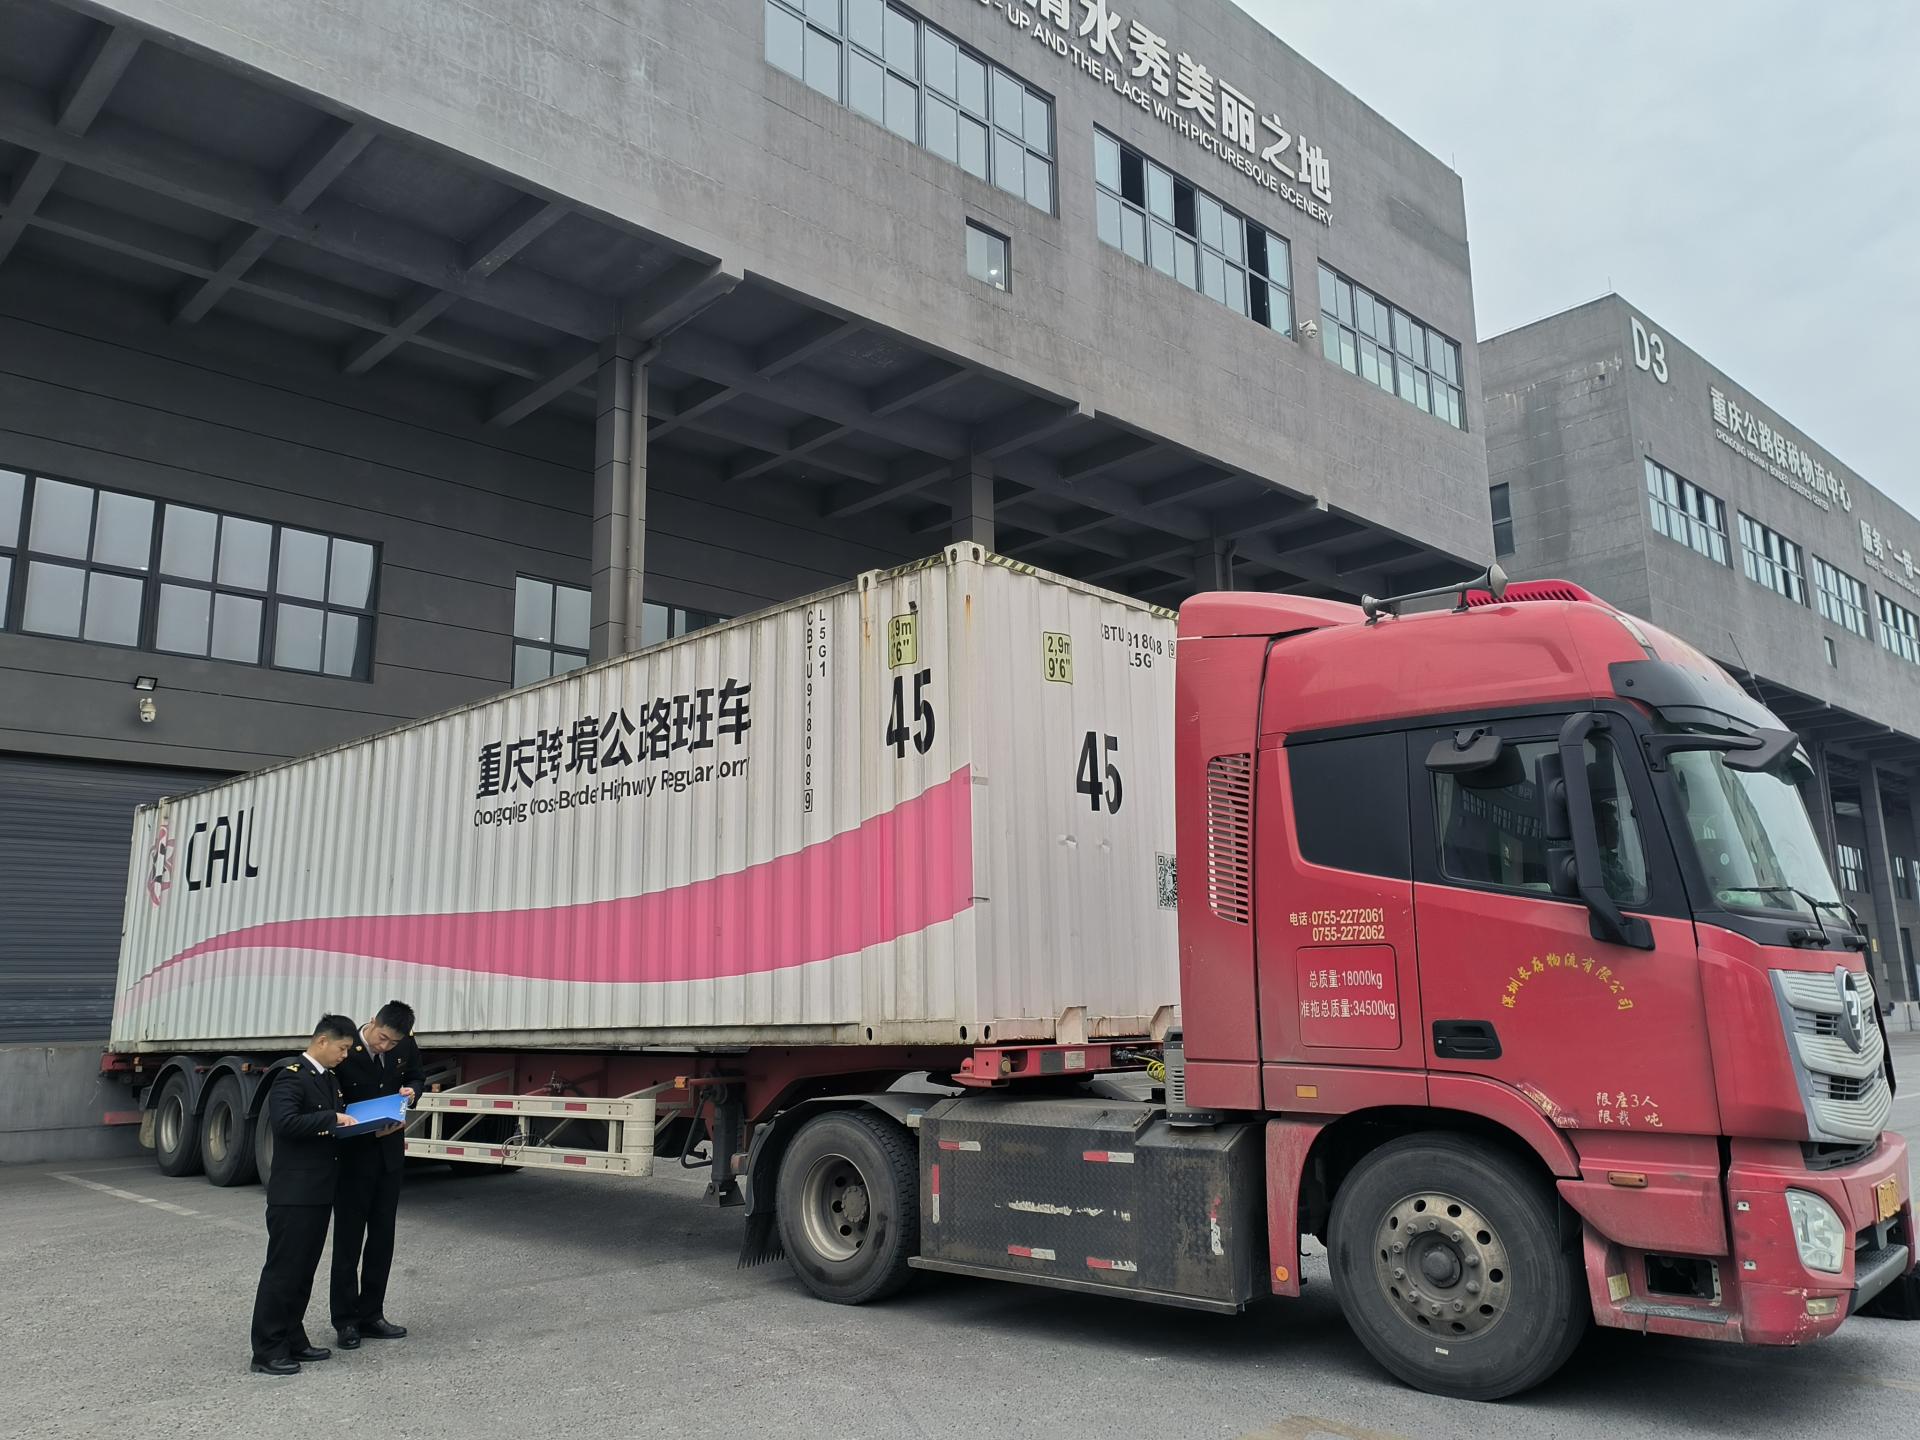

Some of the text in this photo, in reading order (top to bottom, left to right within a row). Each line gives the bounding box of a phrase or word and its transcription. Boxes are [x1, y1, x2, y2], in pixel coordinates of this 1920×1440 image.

[1033, 23, 1068, 56] AND
[1070, 45, 1101, 79] THE
[1104, 67, 1151, 112] PLACE
[1153, 99, 1188, 136] WITH
[1190, 124, 1278, 192] PICTURESQUE
[1280, 183, 1333, 226] SCENERY
[1631, 316, 1668, 383] D3
[1710, 386, 1852, 512] 重庆公路保税物流中心
[818, 609, 826, 678] L5G1
[476, 678, 752, 799] 重庆跨境公路班车
[886, 668, 935, 758] 45
[1076, 731, 1123, 815] 45
[1312, 925, 1385, 941] 0755-2272062
